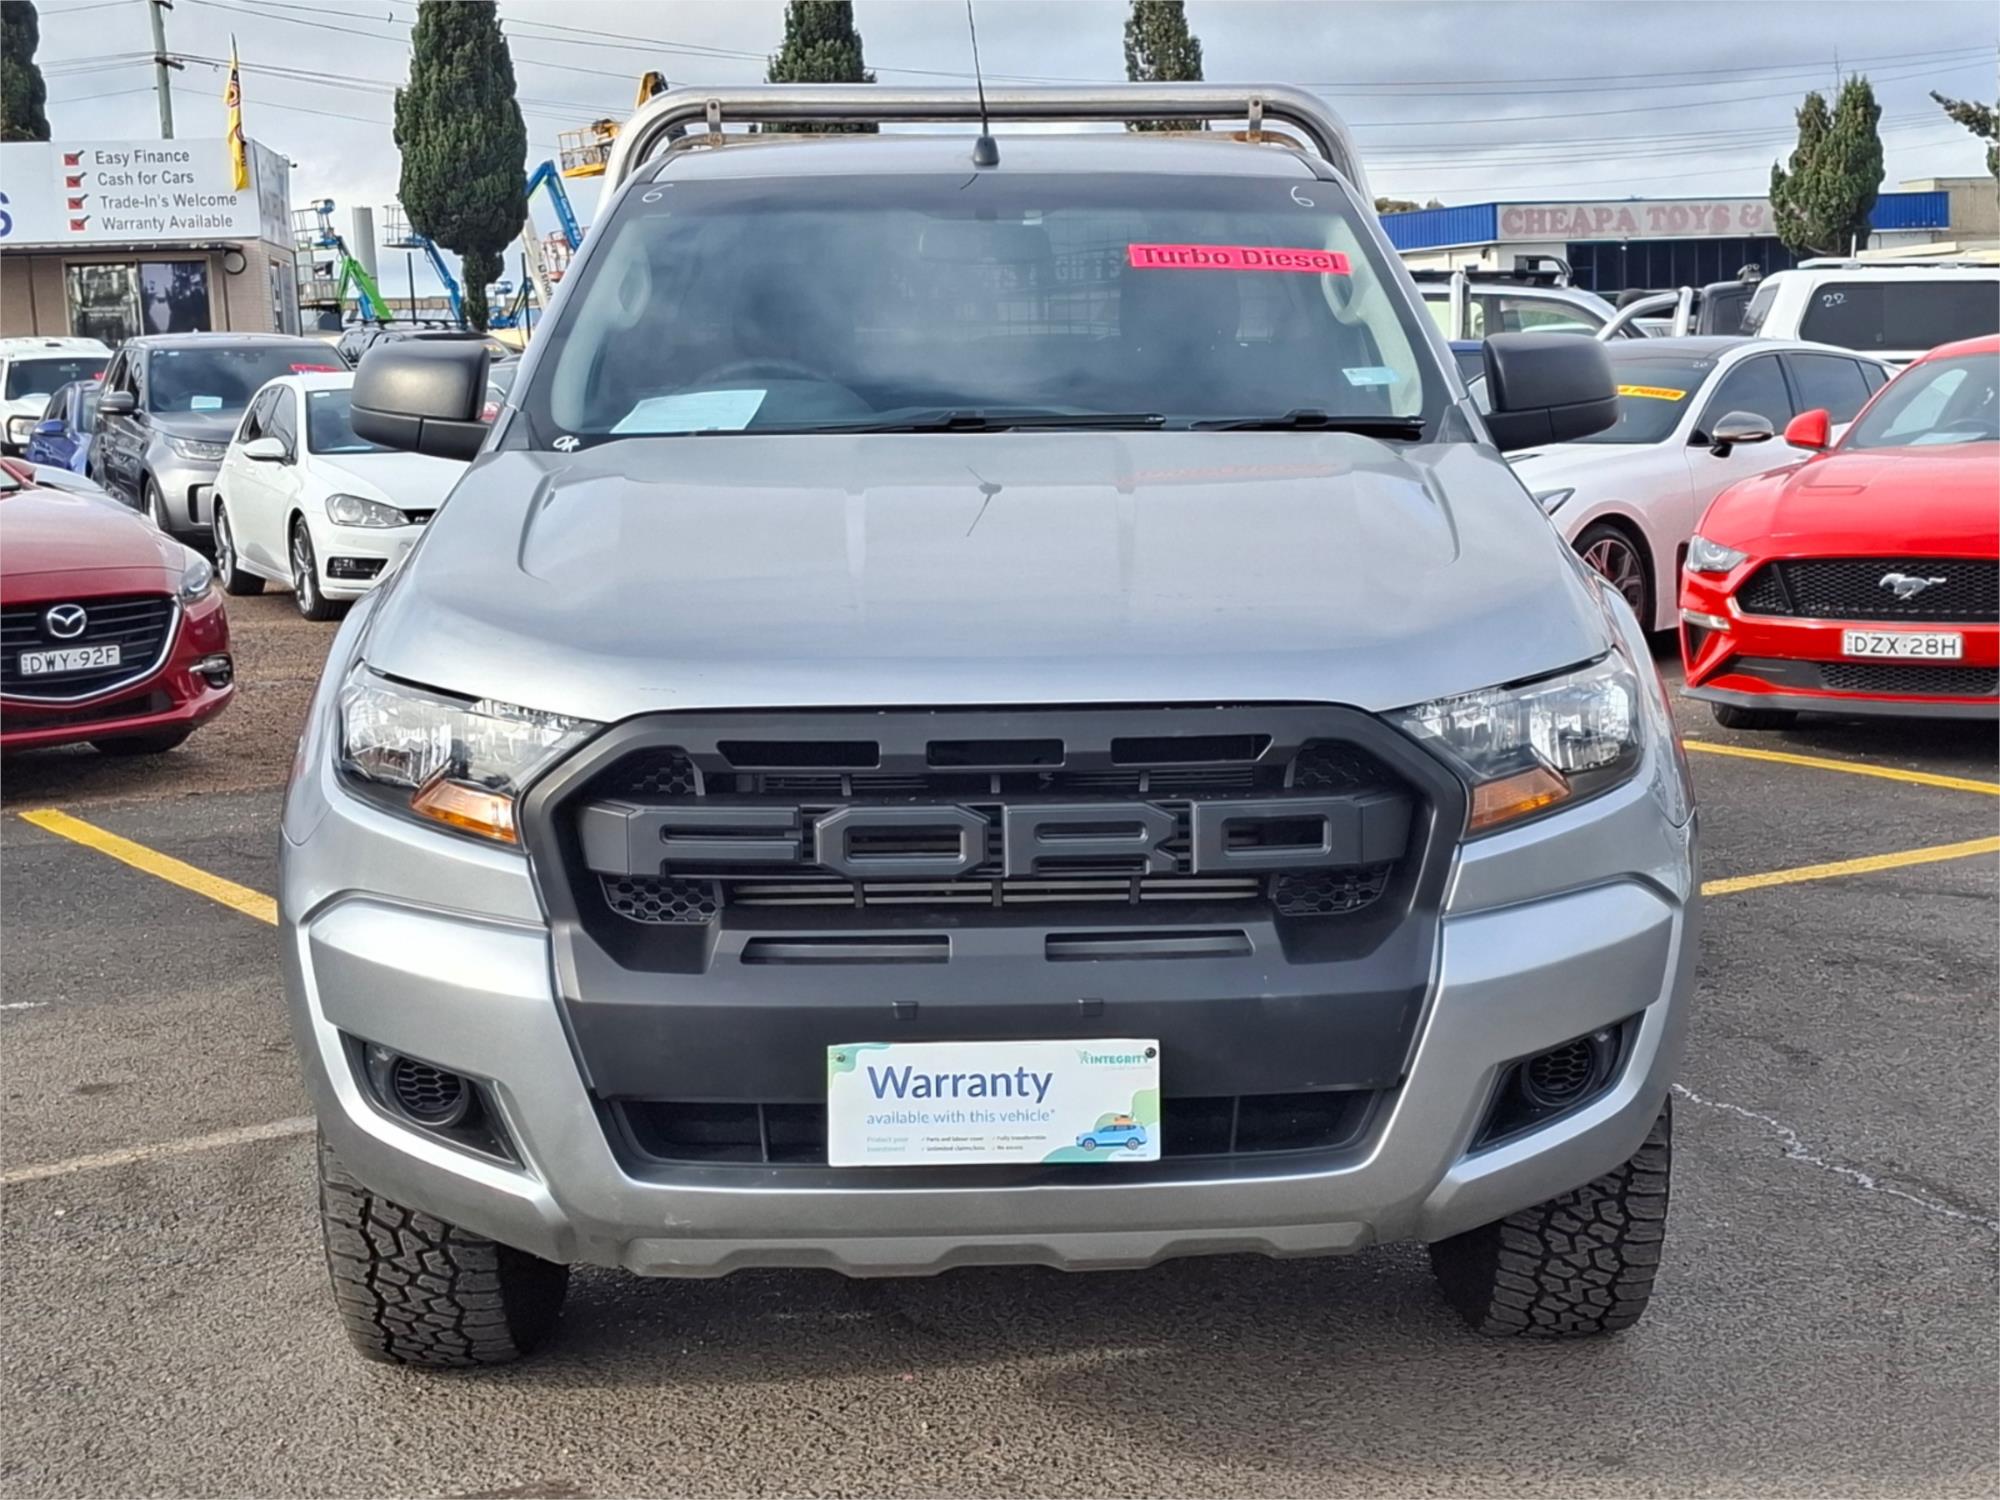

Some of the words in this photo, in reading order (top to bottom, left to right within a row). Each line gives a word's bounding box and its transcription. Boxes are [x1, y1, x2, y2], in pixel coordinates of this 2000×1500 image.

[95, 151, 129, 167] Easy
[134, 149, 190, 164] Finance
[97, 172, 133, 186] Cash
[138, 171, 157, 185] for
[161, 170, 194, 184] Cars
[101, 195, 169, 209] Trade-In's
[173, 193, 237, 207] Welcome
[642, 183, 674, 203] 6
[1290, 186, 1314, 207] 6
[102, 216, 165, 232] Warranty
[169, 213, 233, 229] Available
[1501, 206, 1639, 235] CHEAPA
[1646, 204, 1730, 231] TOYS
[1738, 203, 1764, 228] &
[1138, 247, 1230, 265] Turbo
[1241, 249, 1339, 270] Diesel
[580, 796, 1412, 878] FORD
[1090, 1055, 1148, 1065] INTEGRITY
[867, 1065, 1053, 1104] Warranty
[866, 1110, 929, 1124] available
[933, 1109, 965, 1124] with
[970, 1108, 996, 1122] this
